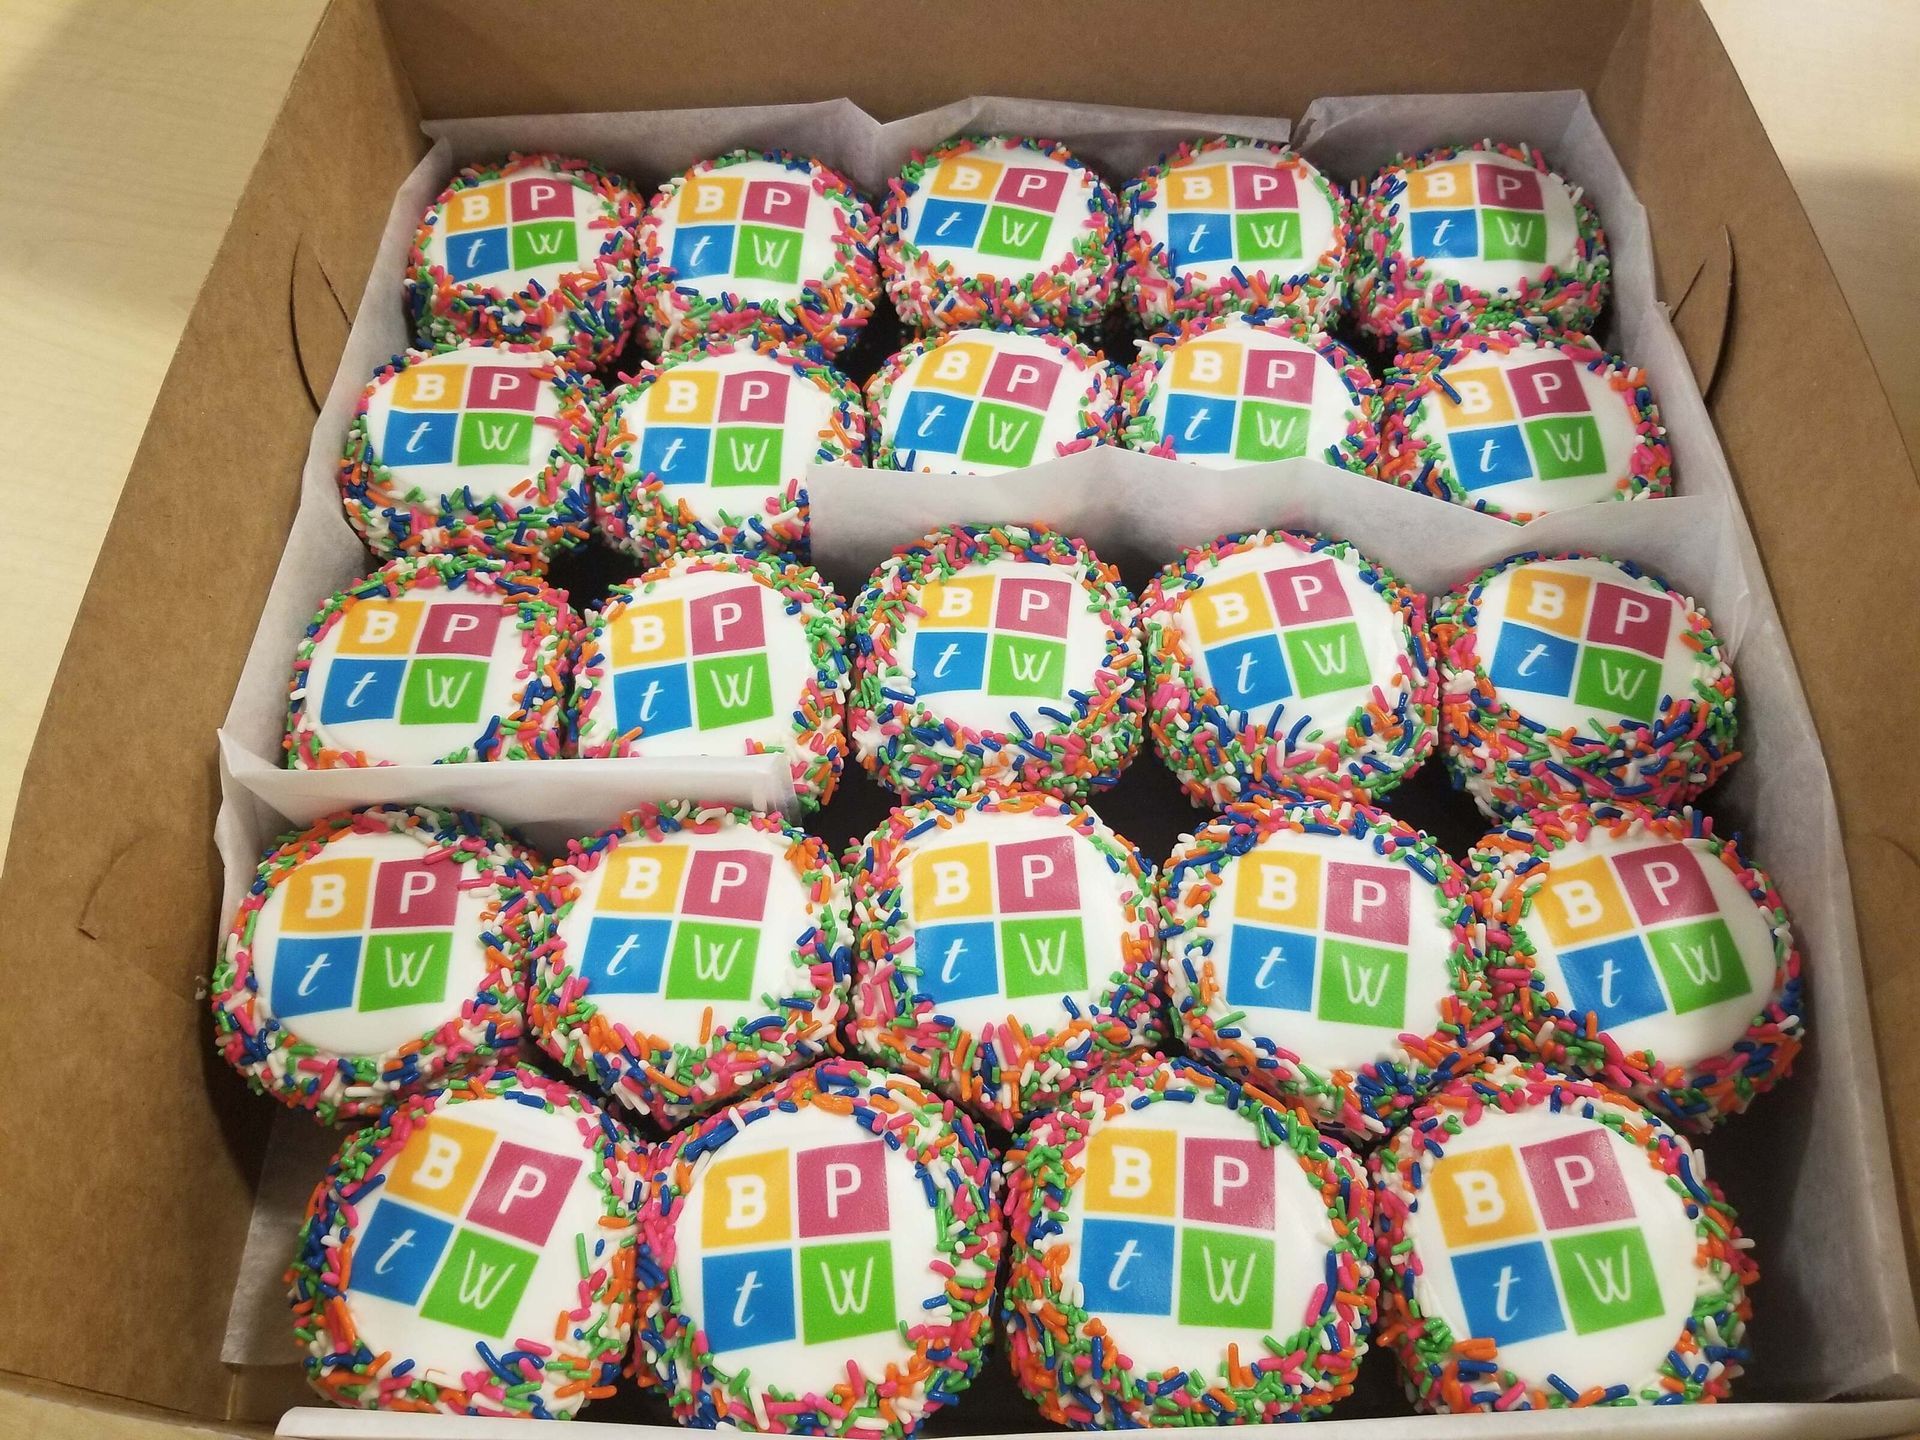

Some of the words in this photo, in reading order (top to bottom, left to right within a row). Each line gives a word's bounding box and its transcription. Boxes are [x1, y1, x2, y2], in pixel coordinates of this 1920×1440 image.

[695, 185, 724, 213] B
[764, 188, 791, 214] P
[949, 166, 982, 190] B
[1018, 175, 1047, 197] P
[1183, 176, 1212, 200] B
[1253, 174, 1278, 200] P
[1425, 172, 1456, 198] B
[1497, 175, 1521, 200] P
[463, 195, 489, 222] B
[531, 186, 556, 210] P
[936, 212, 960, 236] t
[690, 236, 711, 267] t
[1188, 224, 1209, 253] t
[1433, 220, 1452, 246] t
[467, 239, 485, 268] t
[412, 374, 445, 401] B
[490, 374, 520, 400] P
[934, 350, 970, 380] B
[1007, 365, 1040, 392] P
[1190, 350, 1223, 383] B
[1267, 360, 1296, 388] P
[665, 380, 698, 413] B
[740, 381, 769, 411] P
[1453, 381, 1493, 415] B
[1532, 373, 1561, 404] P
[406, 422, 431, 452] t
[918, 405, 944, 436] t
[1184, 409, 1210, 440] t
[660, 438, 685, 471] t
[1480, 440, 1499, 472] t
[938, 587, 972, 617] B
[1020, 589, 1050, 621] P
[1210, 592, 1248, 628] B
[1291, 576, 1322, 611] P
[1528, 581, 1564, 619] B
[1615, 598, 1649, 634] P
[359, 610, 398, 643] B
[443, 614, 479, 642] P
[631, 615, 665, 652] B
[713, 603, 742, 641] P
[934, 644, 960, 678] t
[1237, 653, 1257, 694] t
[1518, 644, 1548, 676] t
[347, 672, 376, 707] t
[640, 681, 663, 721] t
[306, 874, 345, 918] B
[400, 872, 436, 913] P
[620, 858, 661, 899] B
[711, 862, 747, 903] P
[933, 861, 970, 906] B
[1022, 855, 1054, 897] P
[1258, 864, 1296, 910] B
[1353, 879, 1386, 922] P
[1555, 880, 1603, 928] B
[1643, 862, 1679, 906] P
[607, 934, 640, 975] t
[942, 939, 967, 983] t
[1255, 947, 1285, 988] t
[298, 954, 330, 996] t
[1598, 960, 1620, 1008] t
[412, 1134, 461, 1189] B
[498, 1165, 546, 1214] P
[1110, 1146, 1151, 1198] B
[1214, 1156, 1249, 1206] P
[1453, 1170, 1505, 1226] B
[1555, 1156, 1595, 1208] P
[726, 1175, 766, 1229] B
[826, 1163, 861, 1218] P
[375, 1230, 416, 1274] t
[1109, 1240, 1142, 1290] t
[733, 1271, 762, 1326] t
[1494, 1267, 1519, 1321] t
